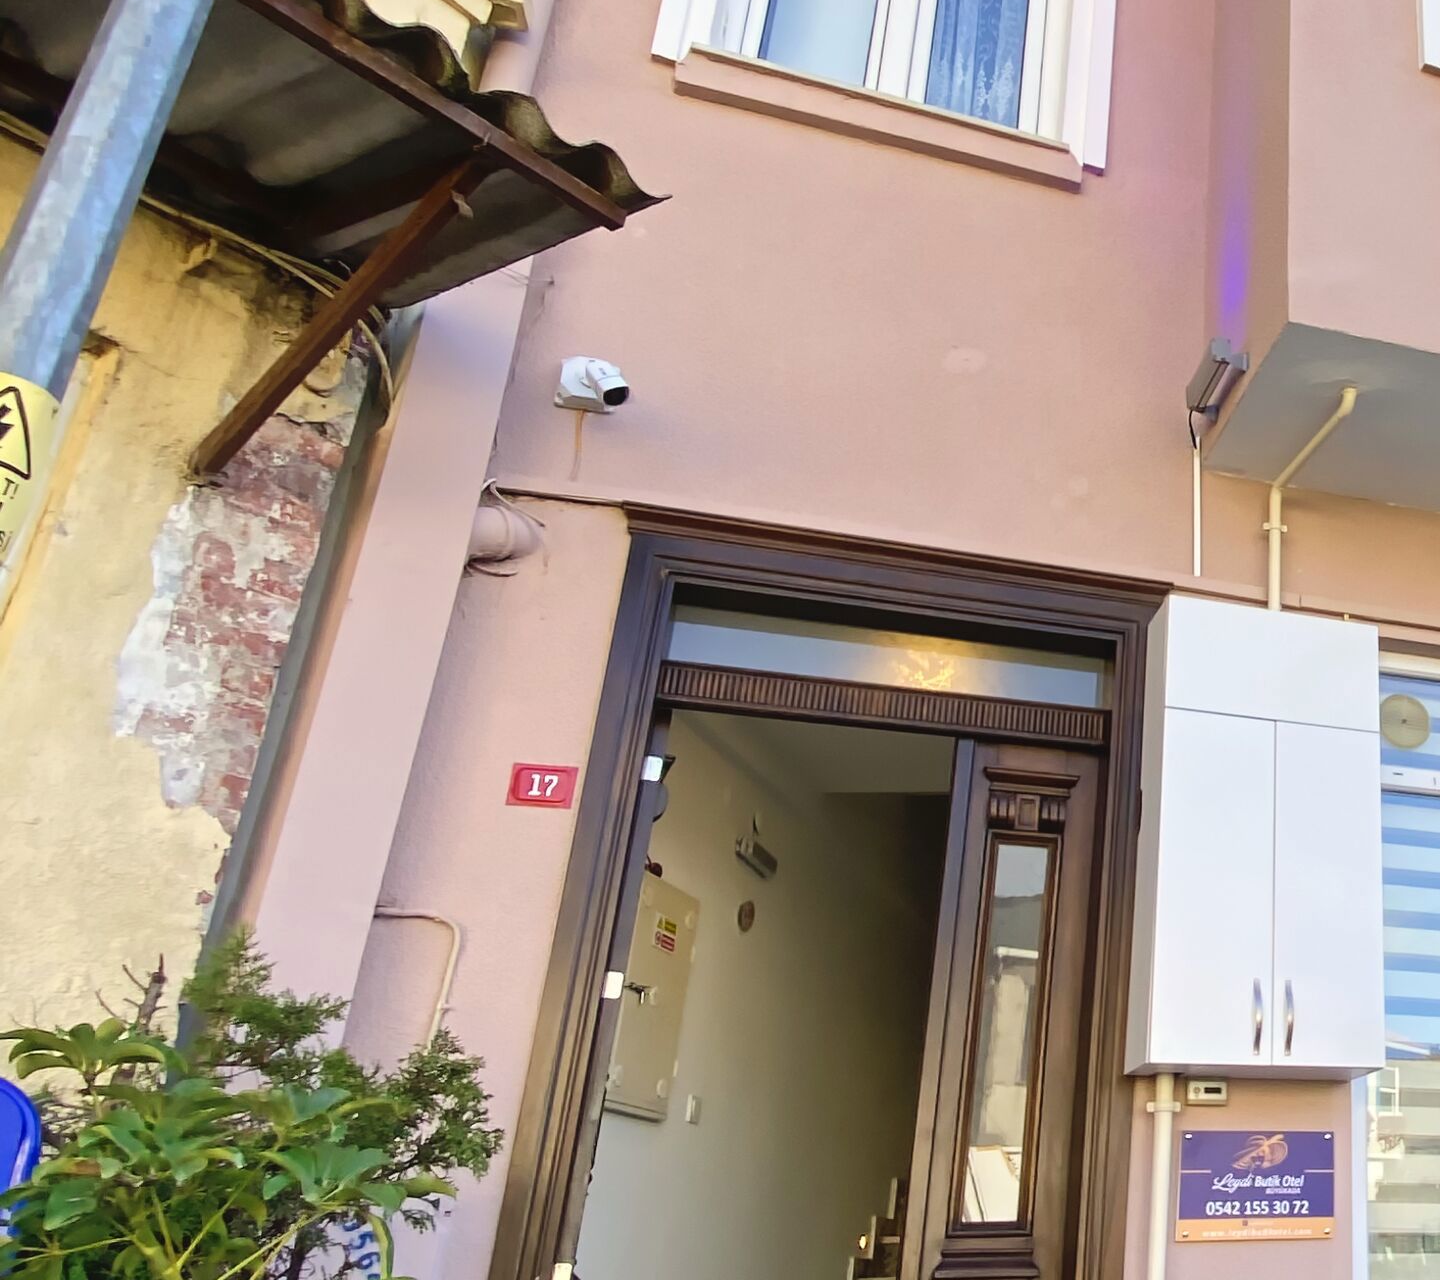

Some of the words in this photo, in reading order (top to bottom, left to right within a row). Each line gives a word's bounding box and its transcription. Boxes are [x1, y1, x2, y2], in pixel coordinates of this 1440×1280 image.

[527, 772, 559, 797] 17
[1254, 1174, 1281, 1188] Butik
[1281, 1174, 1305, 1188] Otel
[1205, 1201, 1241, 1216] 0542
[1244, 1200, 1270, 1215] 155
[1272, 1200, 1290, 1215] 30
[1292, 1200, 1310, 1214] 72
